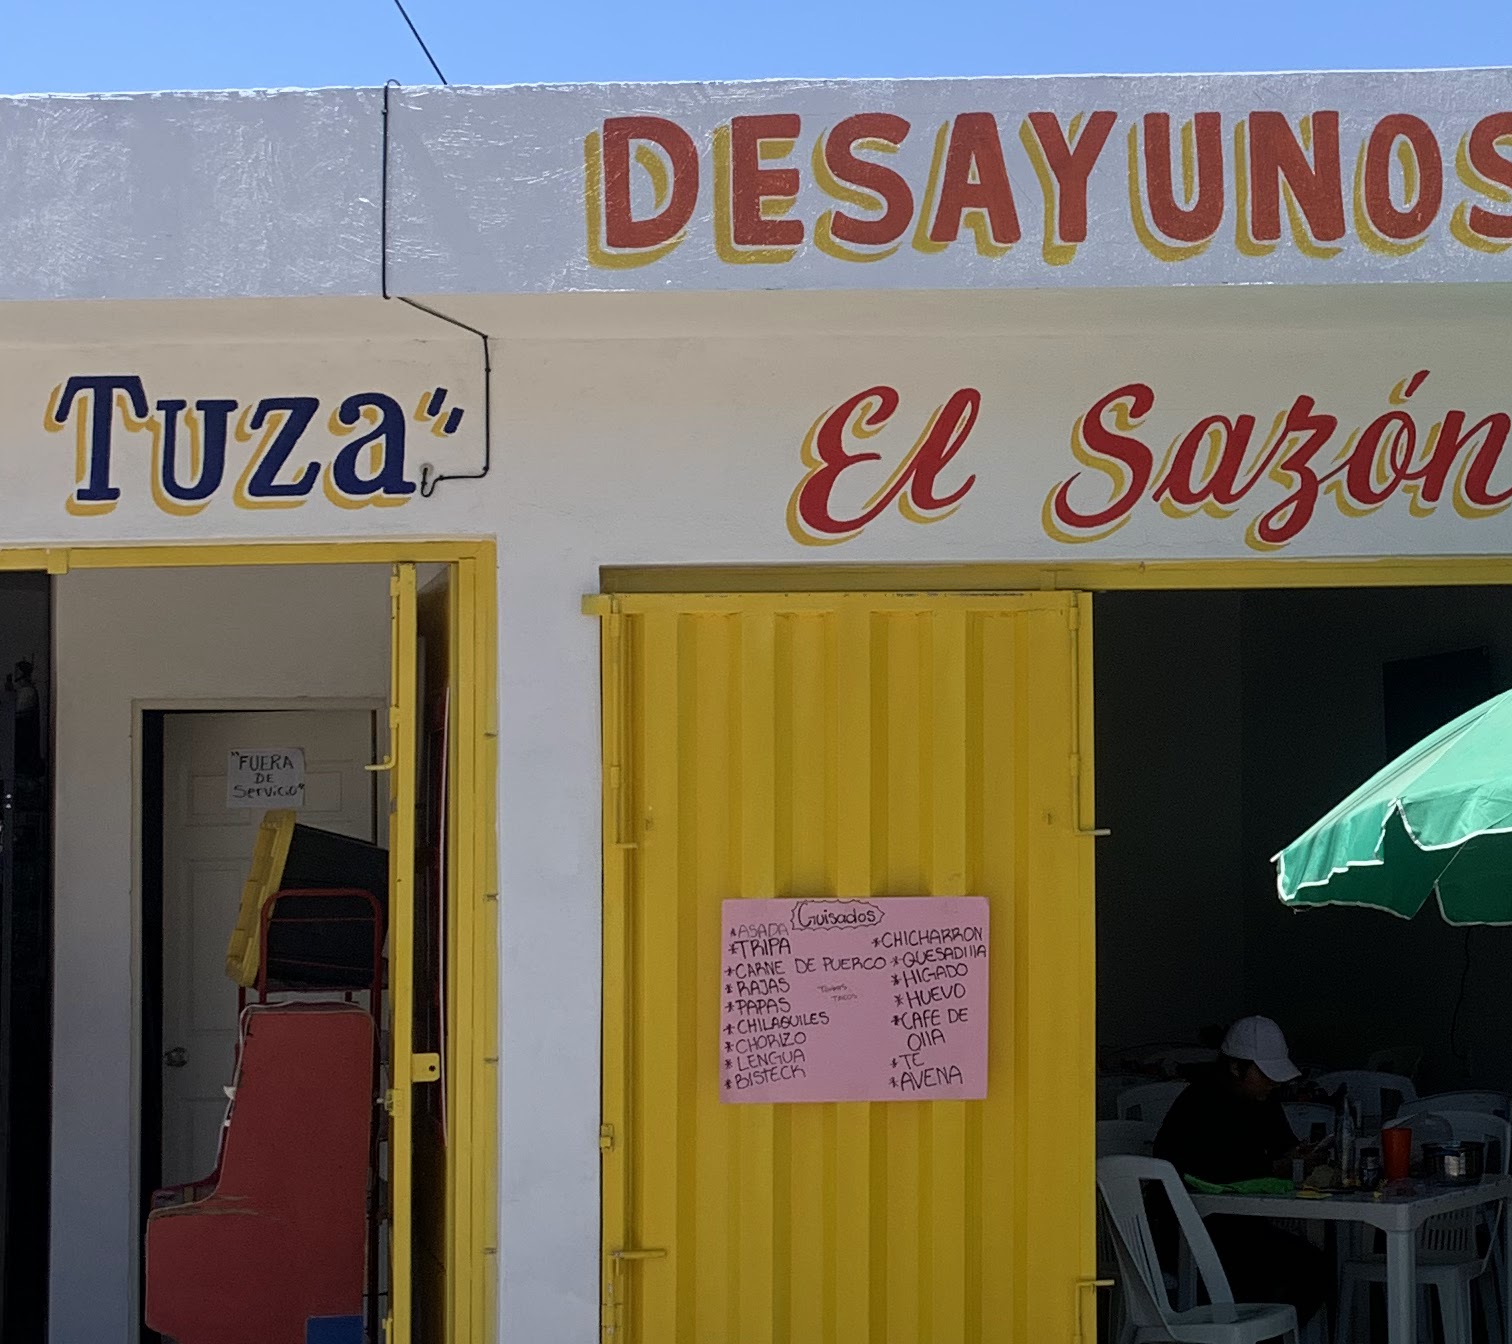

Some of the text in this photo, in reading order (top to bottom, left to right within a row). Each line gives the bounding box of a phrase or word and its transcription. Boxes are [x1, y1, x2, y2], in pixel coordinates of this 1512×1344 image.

[787, 385, 981, 545] El
[255, 773, 274, 784] DE
[798, 901, 876, 927] Guisados
[738, 922, 790, 938] ASADA
[882, 927, 983, 949] CHICHARRON
[735, 937, 791, 959] TRIPA
[735, 956, 887, 979] CARNE DE PUERCO
[903, 963, 968, 988] HIGADO
[736, 977, 791, 997] RAJAS
[906, 983, 966, 1009] HUEVO
[735, 997, 791, 1015] PAPAS
[737, 1011, 830, 1034] CHILAQUILES
[901, 1008, 968, 1030] CAFE DE
[736, 1031, 806, 1054] CHORIZO
[737, 1049, 805, 1071] LENGUA
[899, 1052, 924, 1070] TE
[735, 1064, 806, 1089] BISTECK
[901, 1065, 963, 1091] AVENA
